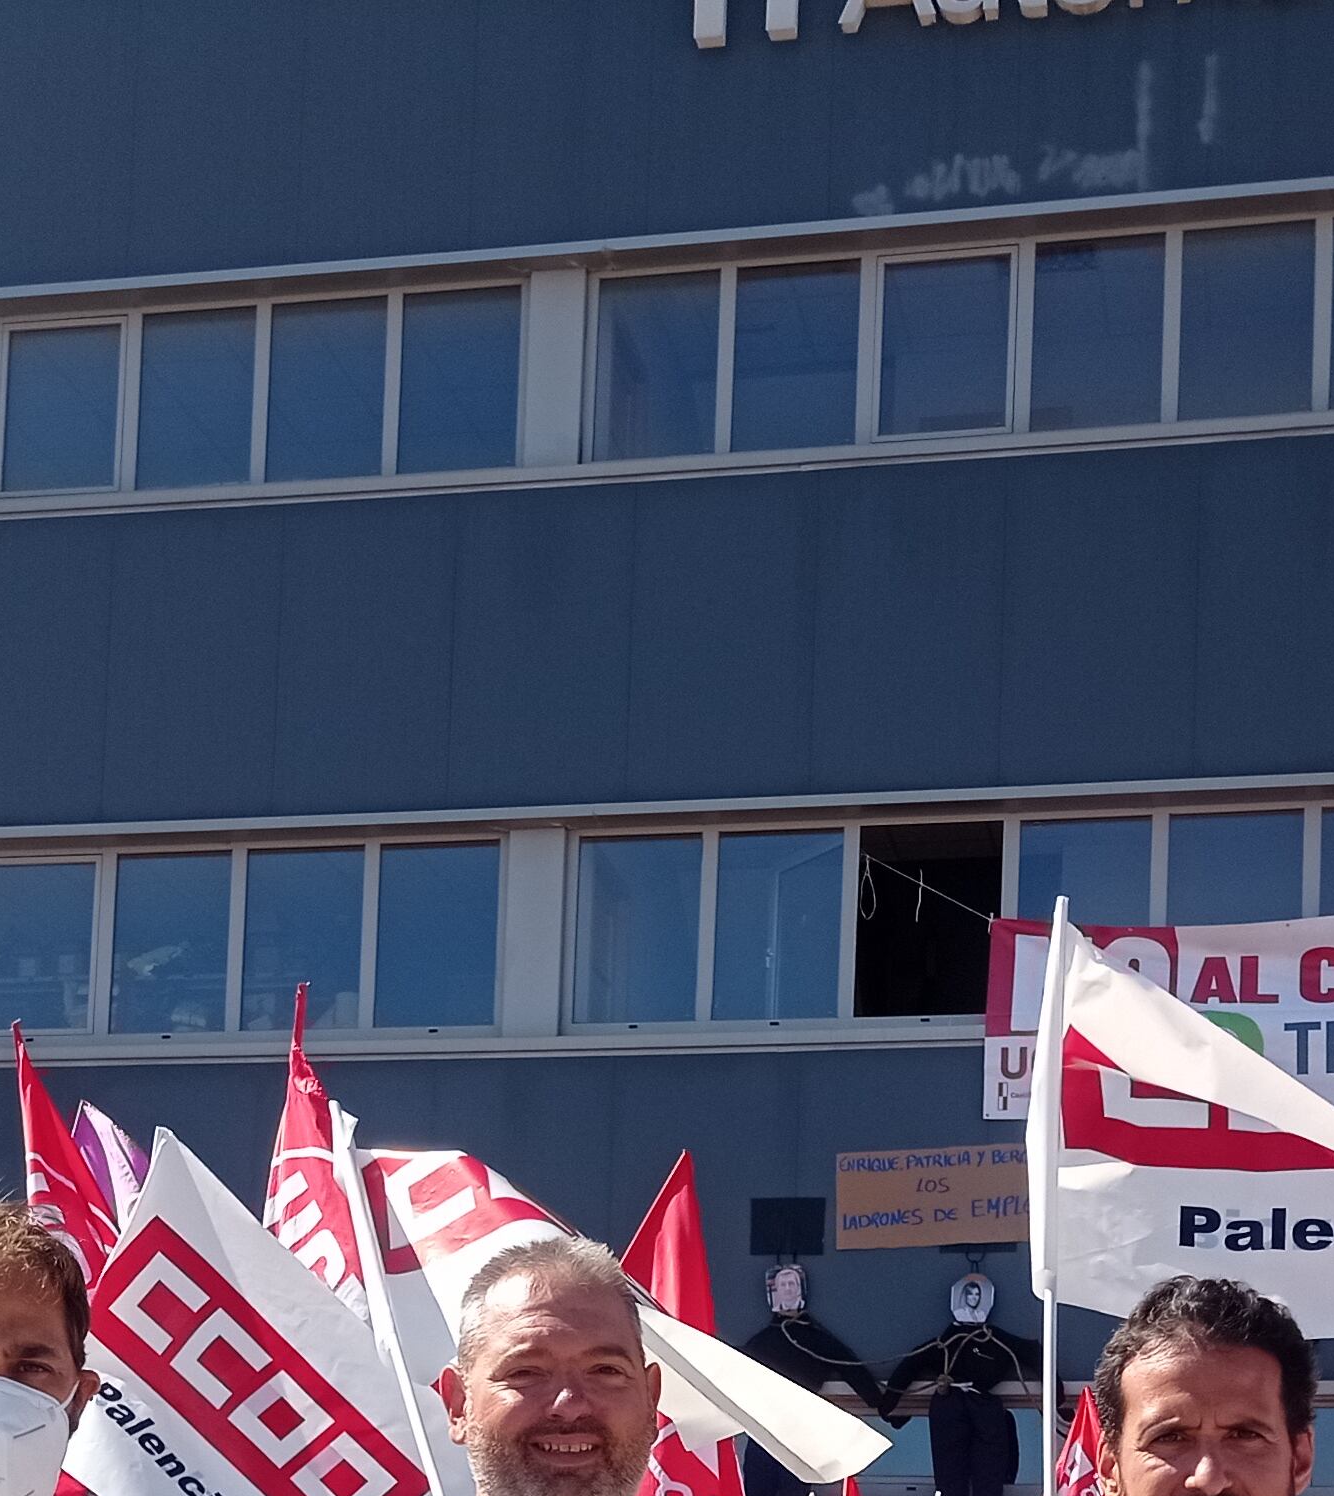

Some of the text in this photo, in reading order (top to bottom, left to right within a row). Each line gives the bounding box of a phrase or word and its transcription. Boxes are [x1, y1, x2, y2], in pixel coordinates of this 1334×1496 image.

[1189, 954, 1280, 1004] AL
[916, 1177, 950, 1194] LOS
[842, 1208, 924, 1231] LADRONES
[934, 1207, 959, 1222] DE
